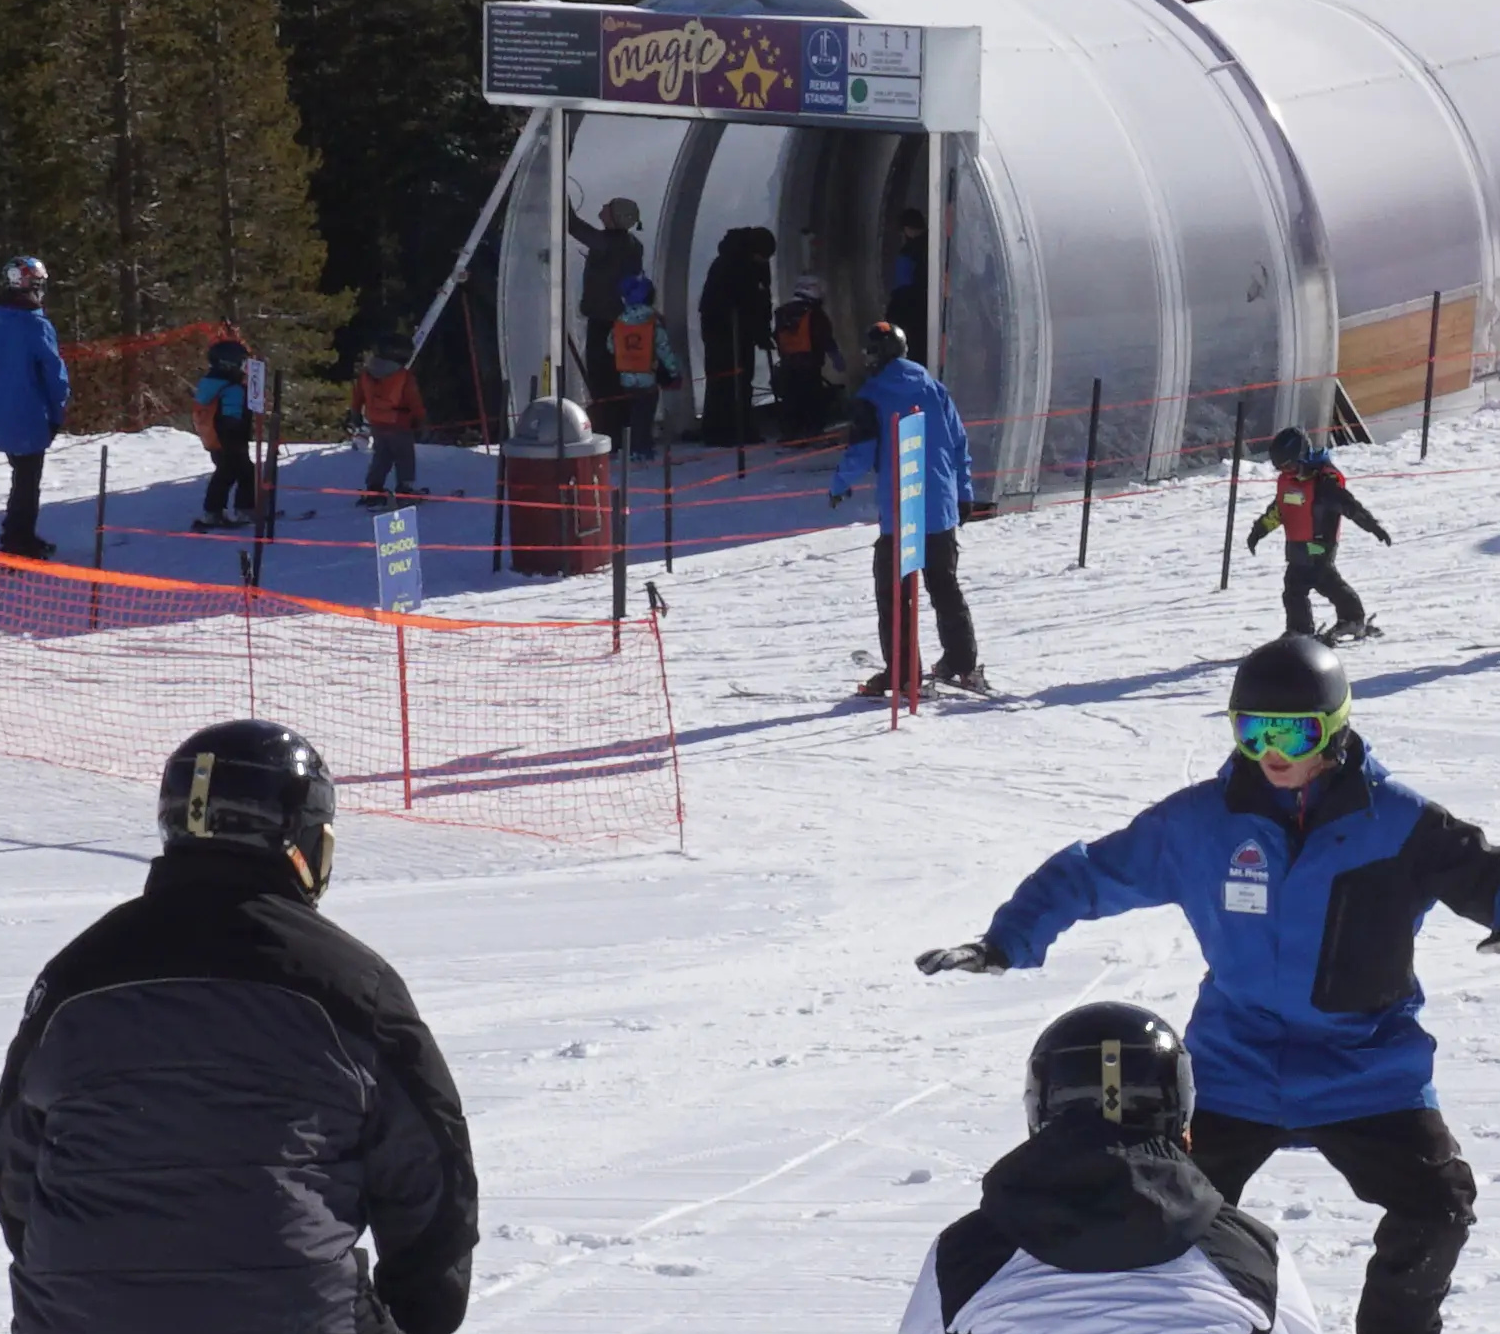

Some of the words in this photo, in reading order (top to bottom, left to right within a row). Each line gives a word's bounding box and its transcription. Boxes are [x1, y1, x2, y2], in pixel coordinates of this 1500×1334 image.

[613, 28, 718, 94] magic
[850, 51, 867, 68] NO
[389, 519, 405, 535] SKI
[380, 537, 417, 557] SCHOOL
[388, 557, 412, 576] ONLY
